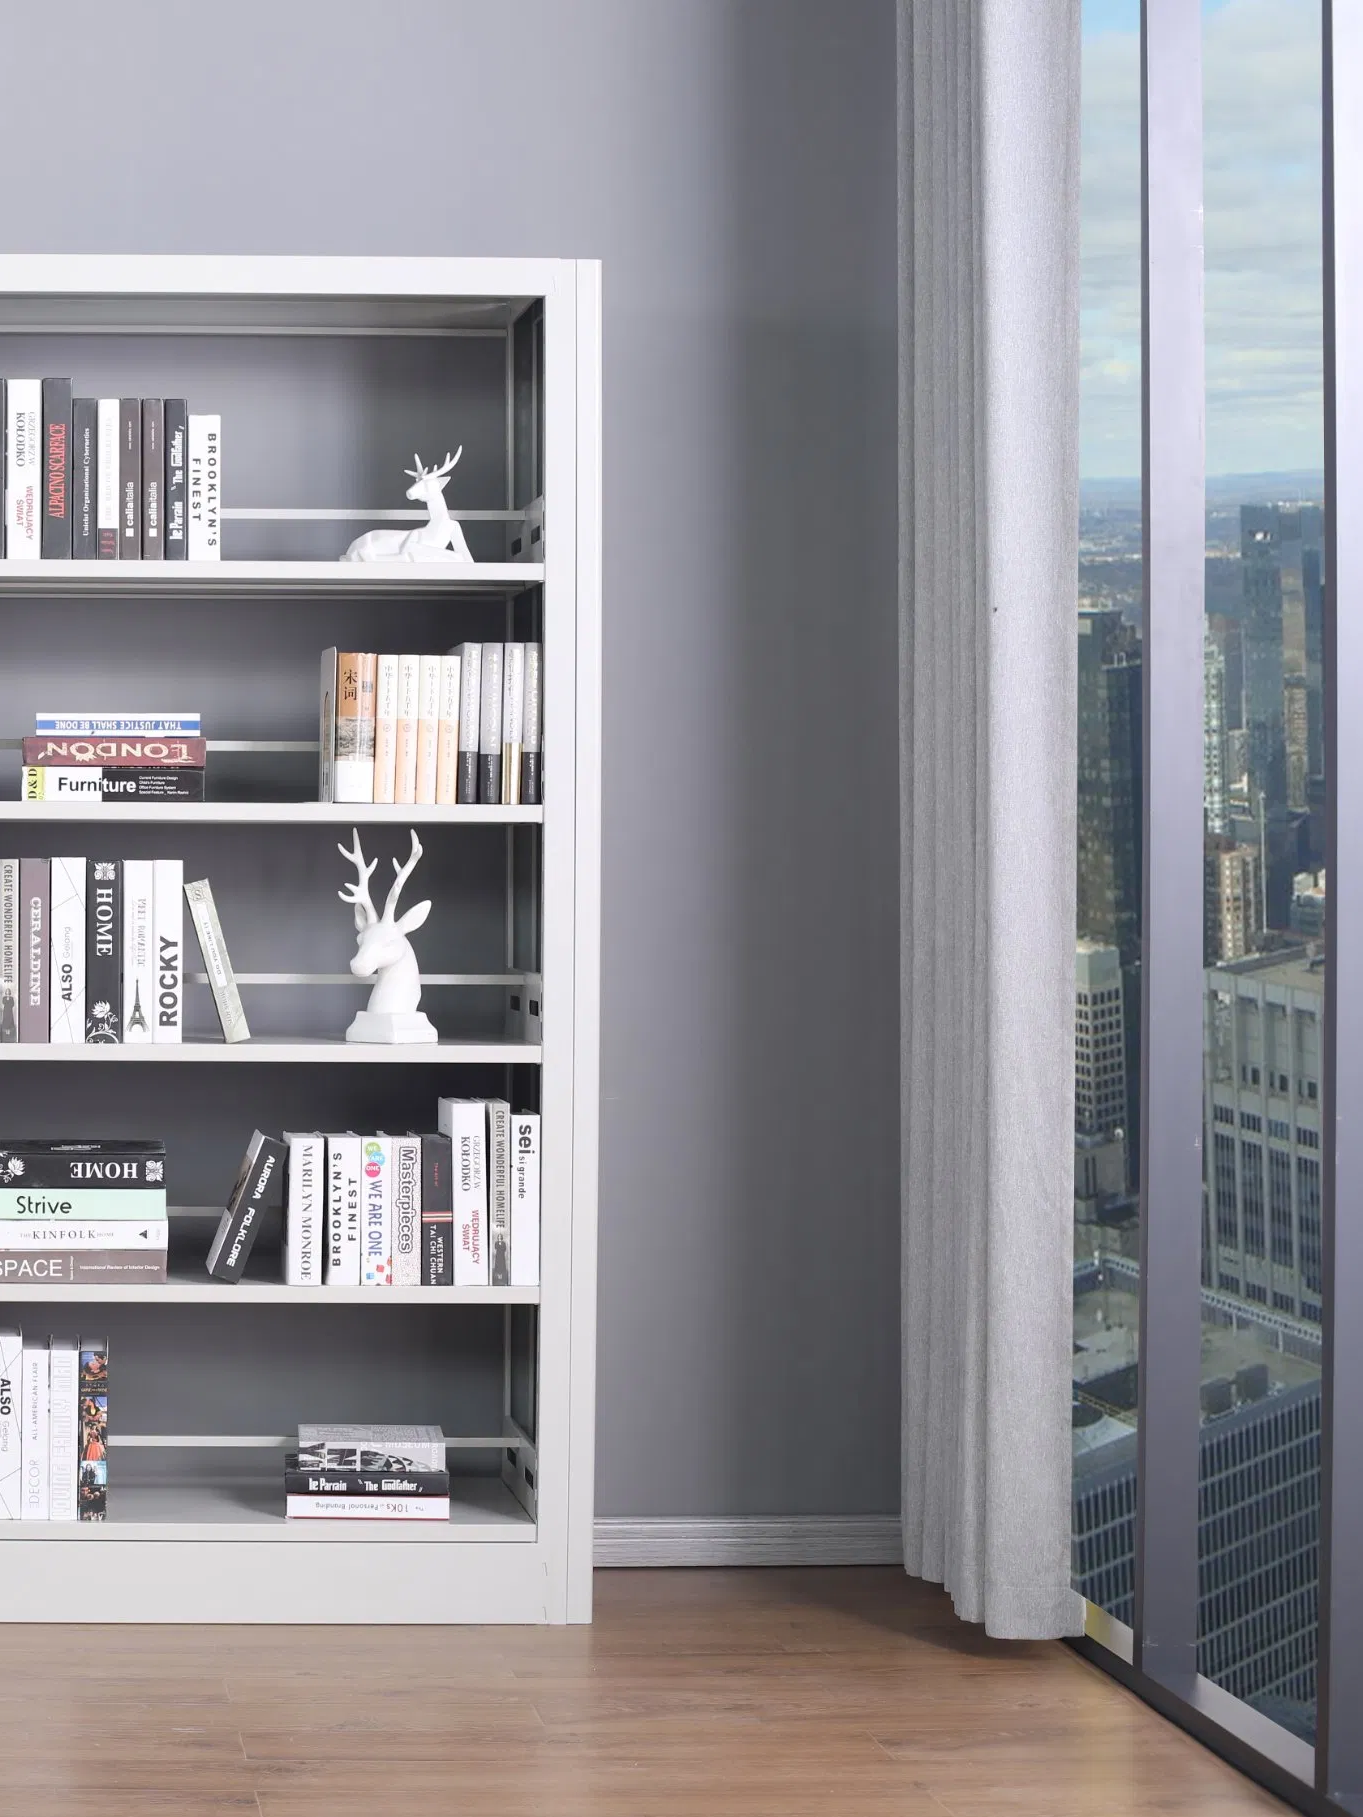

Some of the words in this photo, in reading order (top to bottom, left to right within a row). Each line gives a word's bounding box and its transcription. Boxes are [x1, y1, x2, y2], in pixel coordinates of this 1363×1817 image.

[171, 430, 183, 467] Godfather
[192, 458, 202, 521] FINEST
[207, 433, 217, 547] BROOKLYN'S
[170, 501, 183, 528] Parrain
[344, 669, 358, 701] 宋词
[54, 720, 78, 730] DONE
[80, 720, 89, 730] BE
[92, 720, 118, 730] SHALL
[120, 720, 154, 730] JUSTICE
[158, 720, 182, 730] THAT
[38, 741, 196, 763] LONDON
[58, 777, 137, 793] Furniture
[3, 864, 14, 892] CREATE
[3, 895, 14, 942] WONDERFUL
[96, 887, 113, 957] HOME
[3, 945, 14, 984] HOMELIFE
[61, 963, 73, 1002] ALSO
[158, 936, 178, 1027] ROCKY
[495, 1110, 505, 1138] CREATE
[518, 1124, 535, 1154] sei
[70, 1162, 139, 1179] HOME
[252, 1154, 276, 1200] AURORA
[301, 1144, 313, 1211] MARILYN
[460, 1136, 471, 1192] KOŁODKO
[495, 1140, 505, 1188] WONDERFUL
[368, 1179, 382, 1200] WE
[516, 1167, 527, 1199] grande
[16, 1195, 73, 1214] Strive
[332, 1152, 342, 1267] BROOKLYN'S
[348, 1177, 357, 1242] FINEST
[368, 1203, 382, 1228] ARE
[399, 1146, 417, 1254] Masterpieces
[495, 1190, 505, 1228] HOMELIFE
[32, 1230, 96, 1240] KINFOLK
[226, 1206, 256, 1268] FOLKLORE
[301, 1214, 311, 1281] MONROE
[368, 1231, 382, 1258] ONE
[461, 1224, 470, 1252] ŚWIAT
[470, 1209, 480, 1265] WĘDRUJĄCY
[0, 1378, 11, 1415] ALSO
[52, 1399, 72, 1458] FAMILY
[319, 1478, 347, 1492] Parrain
[364, 1480, 378, 1491] The
[381, 1479, 418, 1491] Godfather
[315, 1502, 346, 1510] Branding
[348, 1503, 379, 1511] Personal
[386, 1503, 409, 1513] 10Ks
